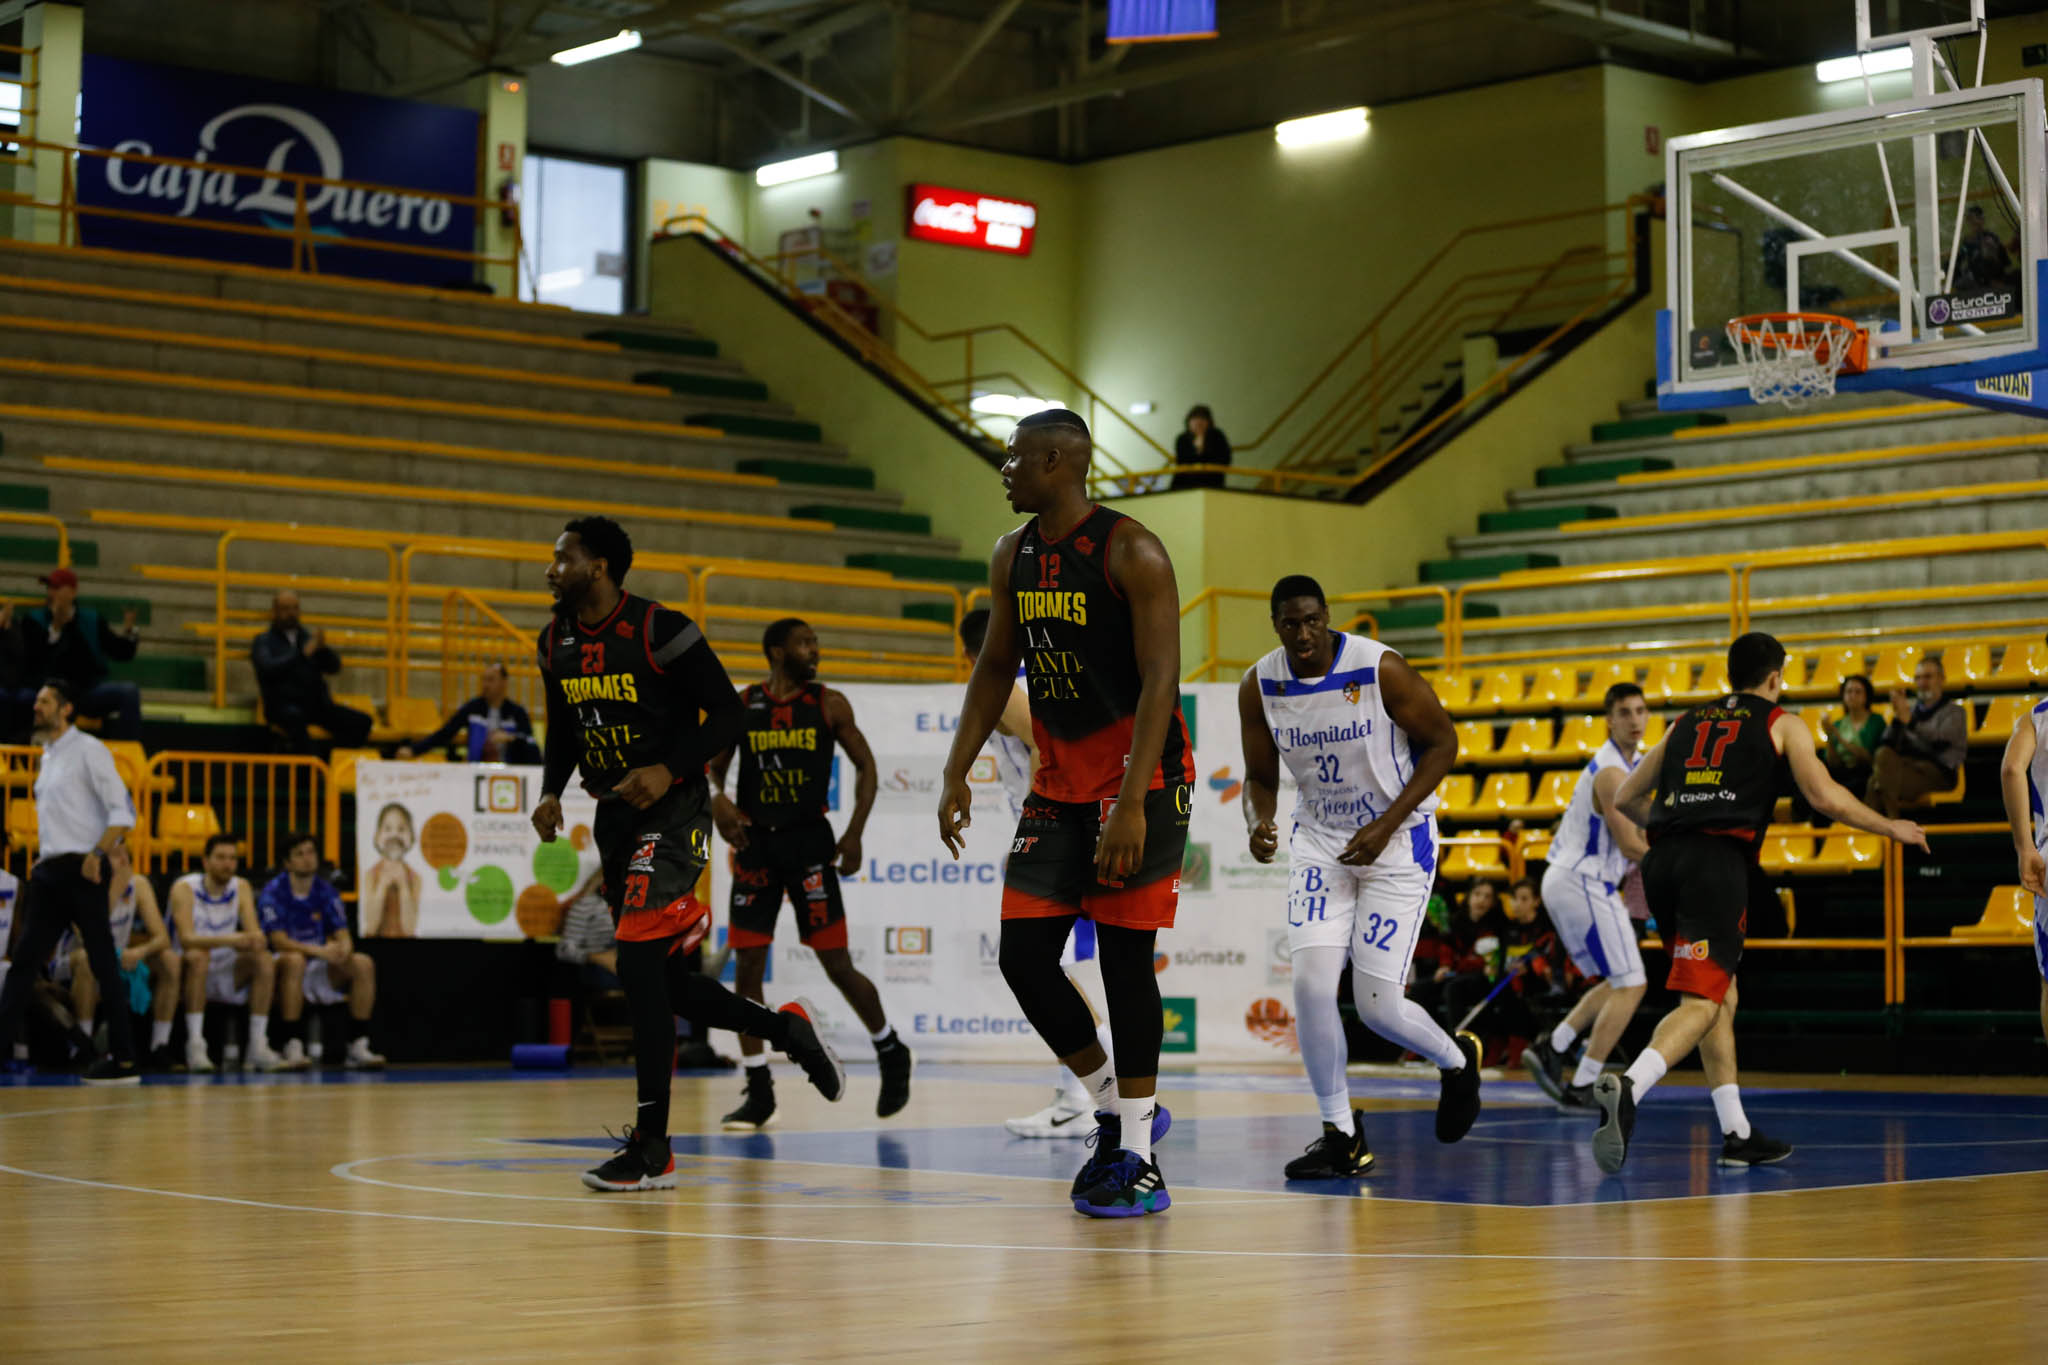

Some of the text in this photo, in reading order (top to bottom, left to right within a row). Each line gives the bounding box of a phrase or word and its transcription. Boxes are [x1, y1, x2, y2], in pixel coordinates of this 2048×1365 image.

[105, 103, 452, 234] Caja Duero
[1951, 291, 2012, 310] EuroCup
[1952, 304, 2006, 321] women
[1038, 553, 1061, 588] 12
[1016, 590, 1087, 626] TORMES
[1026, 626, 1053, 649] LA
[581, 641, 605, 674] 23
[560, 672, 639, 704] TORMES
[1033, 676, 1080, 699] GUA
[747, 727, 817, 753] TORMES
[1684, 720, 1742, 768] 17
[1315, 753, 1344, 784] 32
[1011, 836, 1039, 854] BT
[840, 858, 995, 885] .Leclerc
[623, 873, 650, 908] 23
[1363, 912, 1398, 953] 32
[1174, 948, 1246, 966] súmate
[914, 1013, 1031, 1034] E.Leclerc
